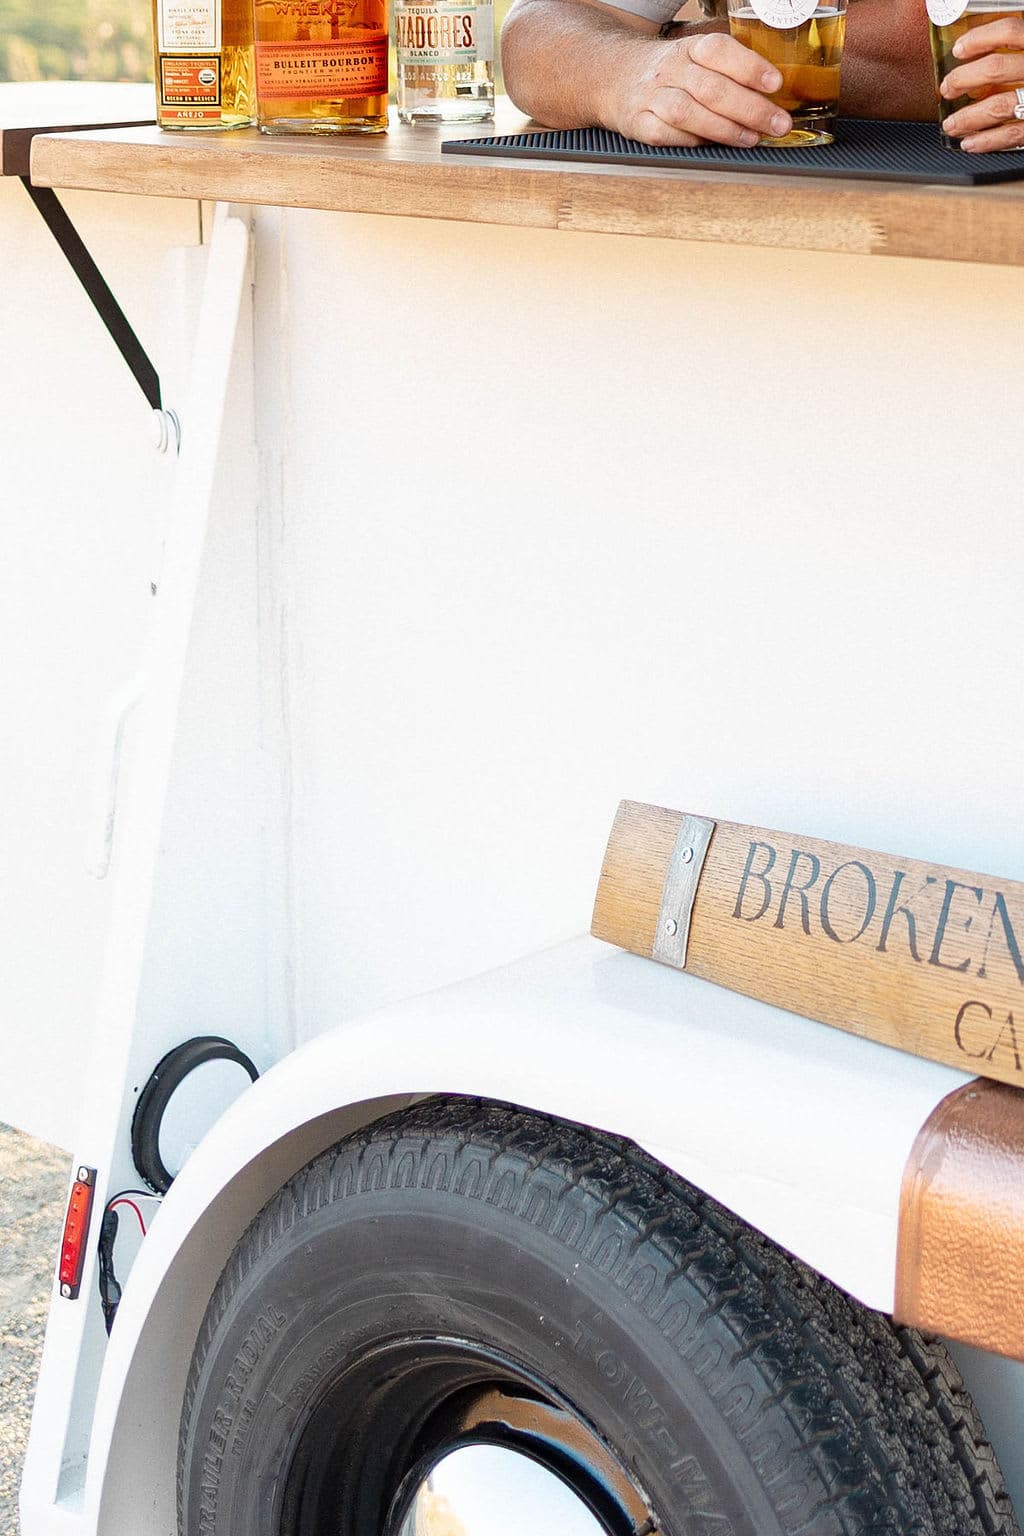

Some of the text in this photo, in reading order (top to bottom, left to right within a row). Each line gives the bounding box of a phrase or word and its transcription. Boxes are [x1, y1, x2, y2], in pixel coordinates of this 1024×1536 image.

[408, 7, 439, 15] TEQUILA
[274, 59, 317, 69] BULLEIT
[322, 56, 374, 67] BOURBON
